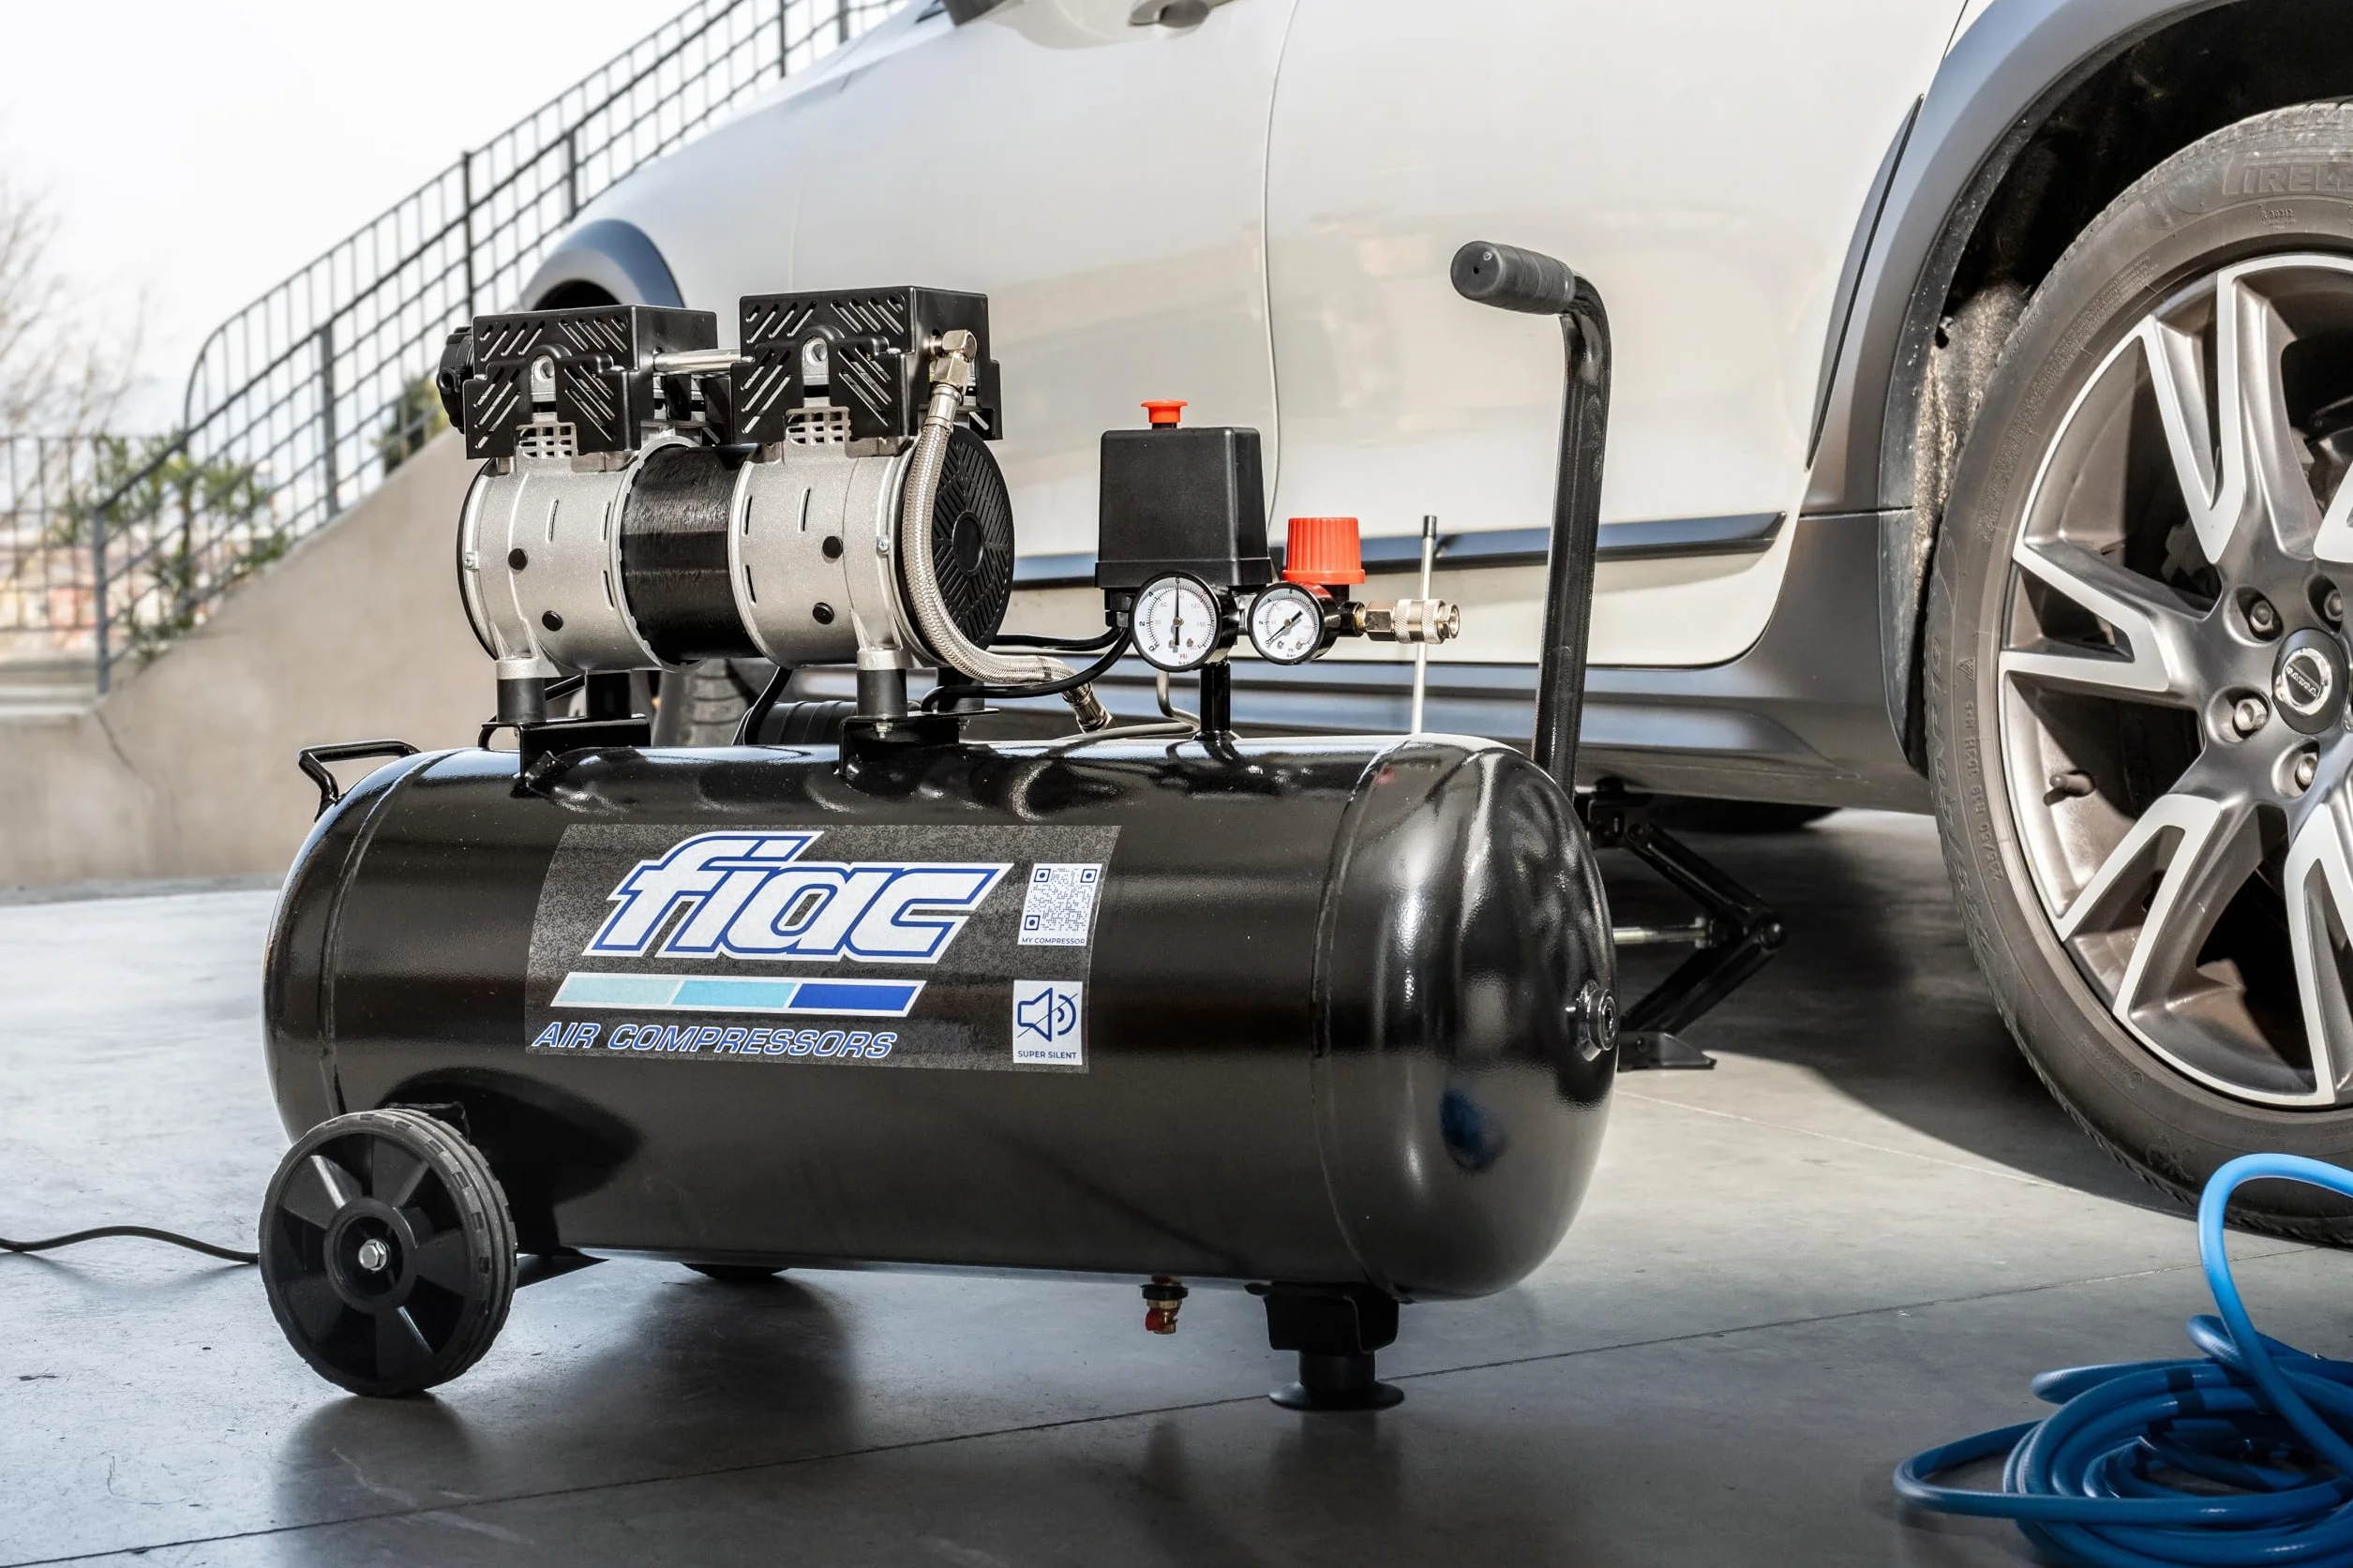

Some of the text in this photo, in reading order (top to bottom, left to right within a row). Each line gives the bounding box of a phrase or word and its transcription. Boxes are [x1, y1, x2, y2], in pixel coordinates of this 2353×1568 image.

[2286, 665, 2316, 697] VOLVO
[581, 830, 1014, 963] fiac
[532, 1022, 898, 1058] AIR COMPRESSORS
[1017, 1050, 1077, 1060] SUPER SILENT
